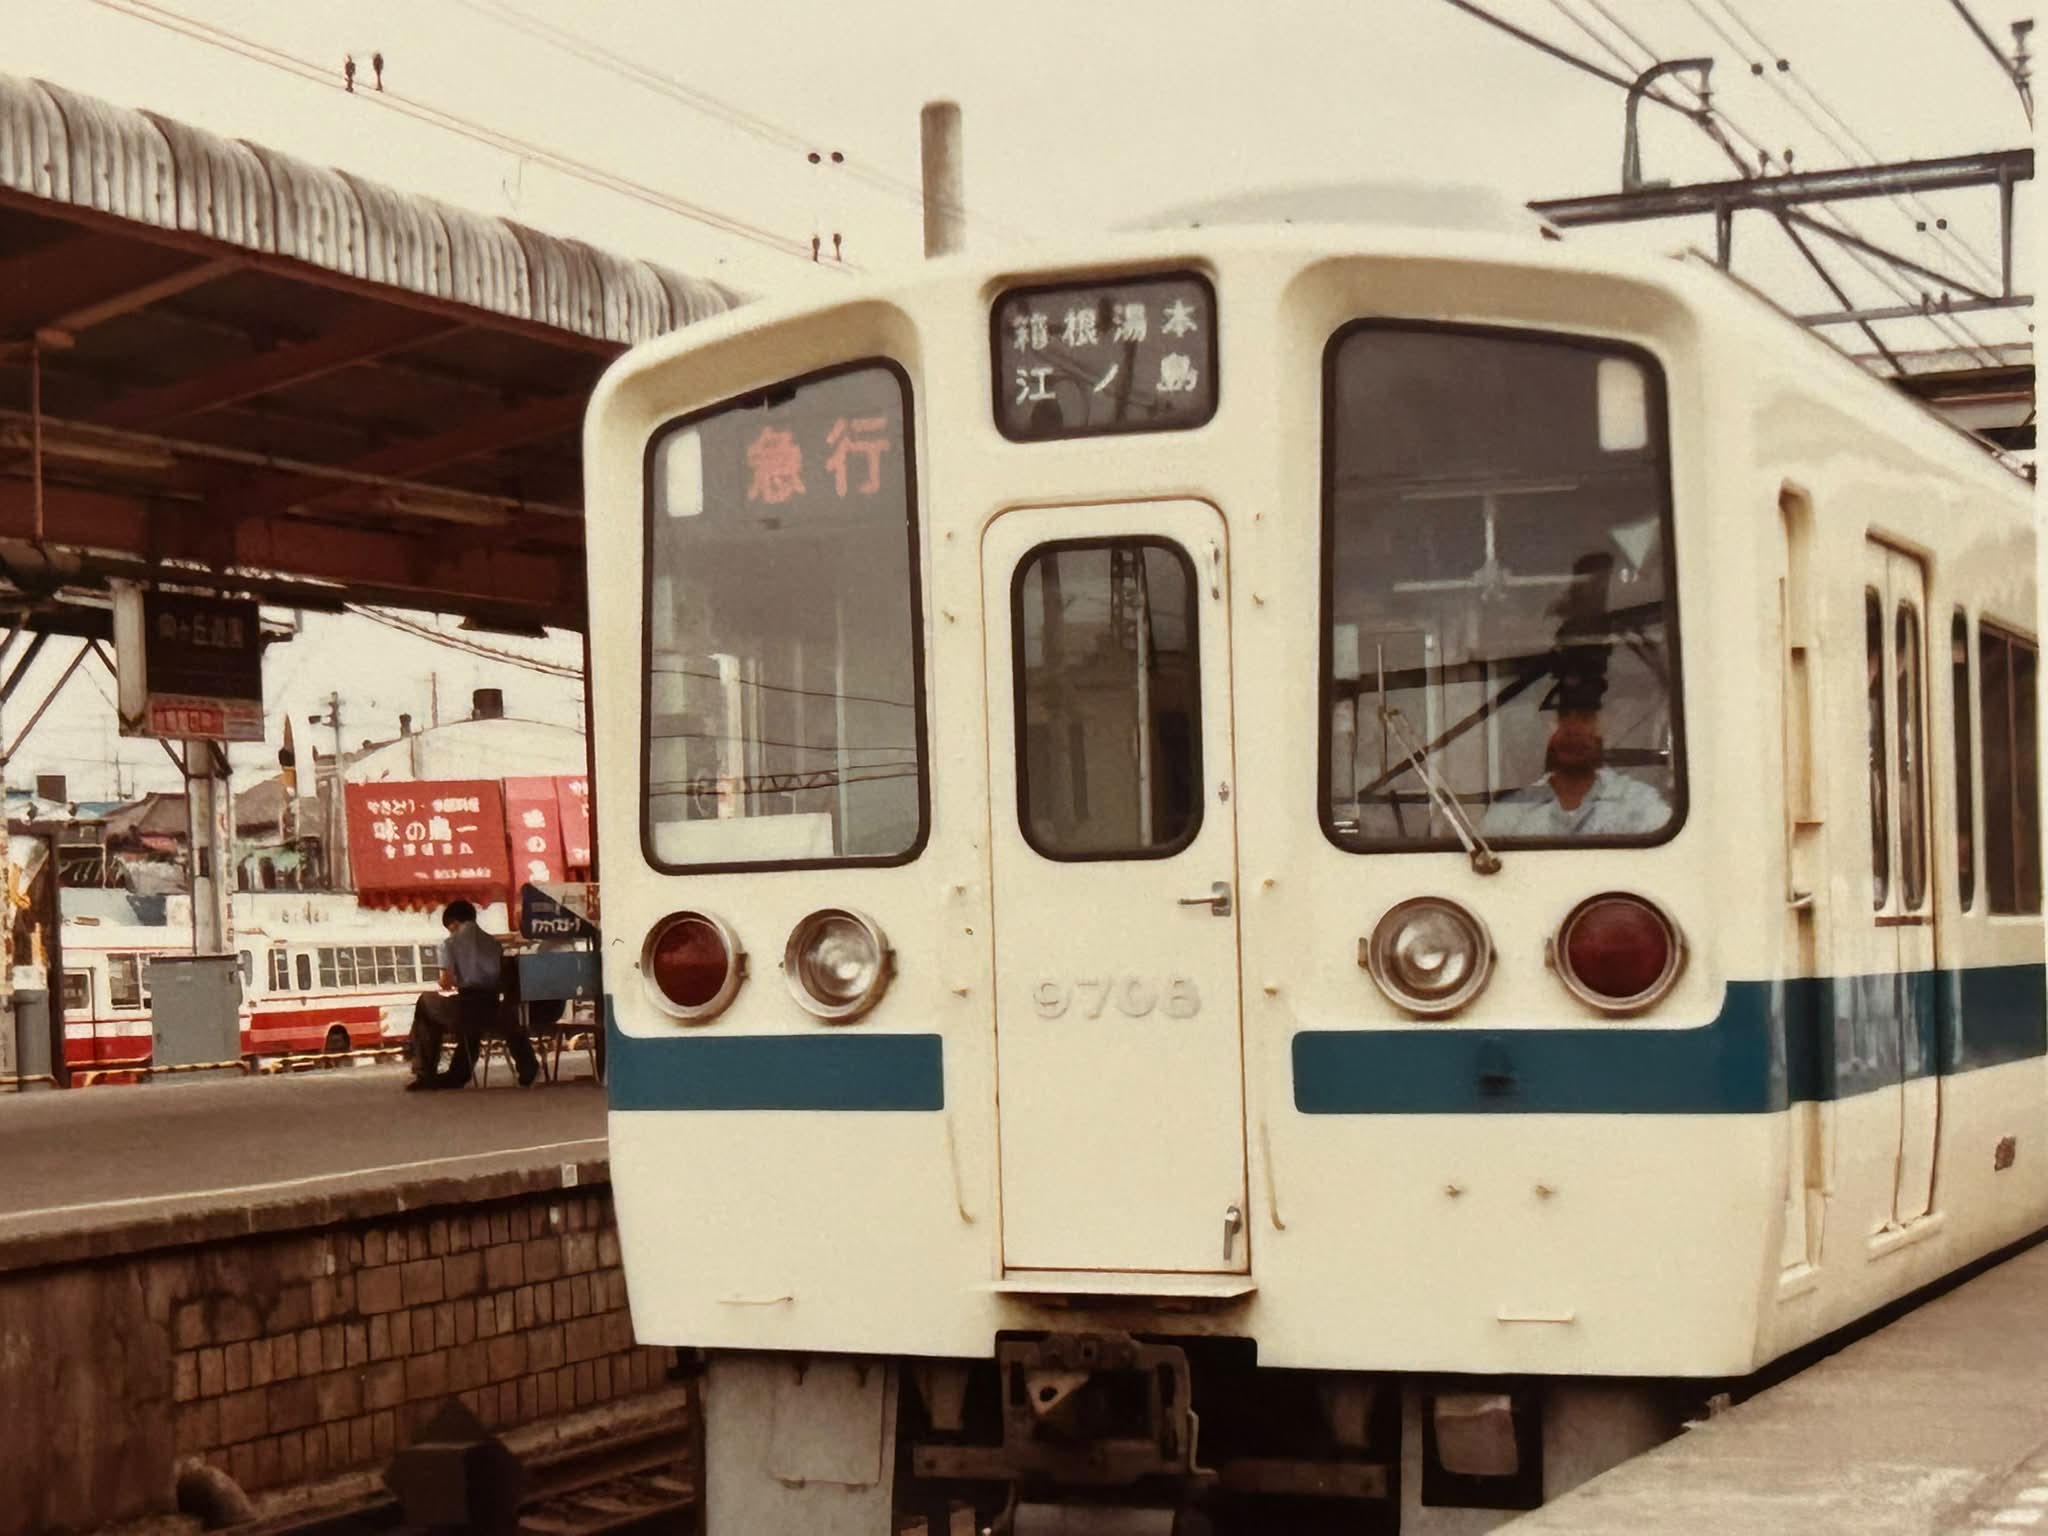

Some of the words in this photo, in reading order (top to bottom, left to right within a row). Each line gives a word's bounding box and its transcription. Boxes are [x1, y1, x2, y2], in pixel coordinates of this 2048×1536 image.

[1011, 300, 1198, 352] 箱根湯本
[1015, 353, 1198, 406] 江ノ島
[746, 416, 890, 504] 急行
